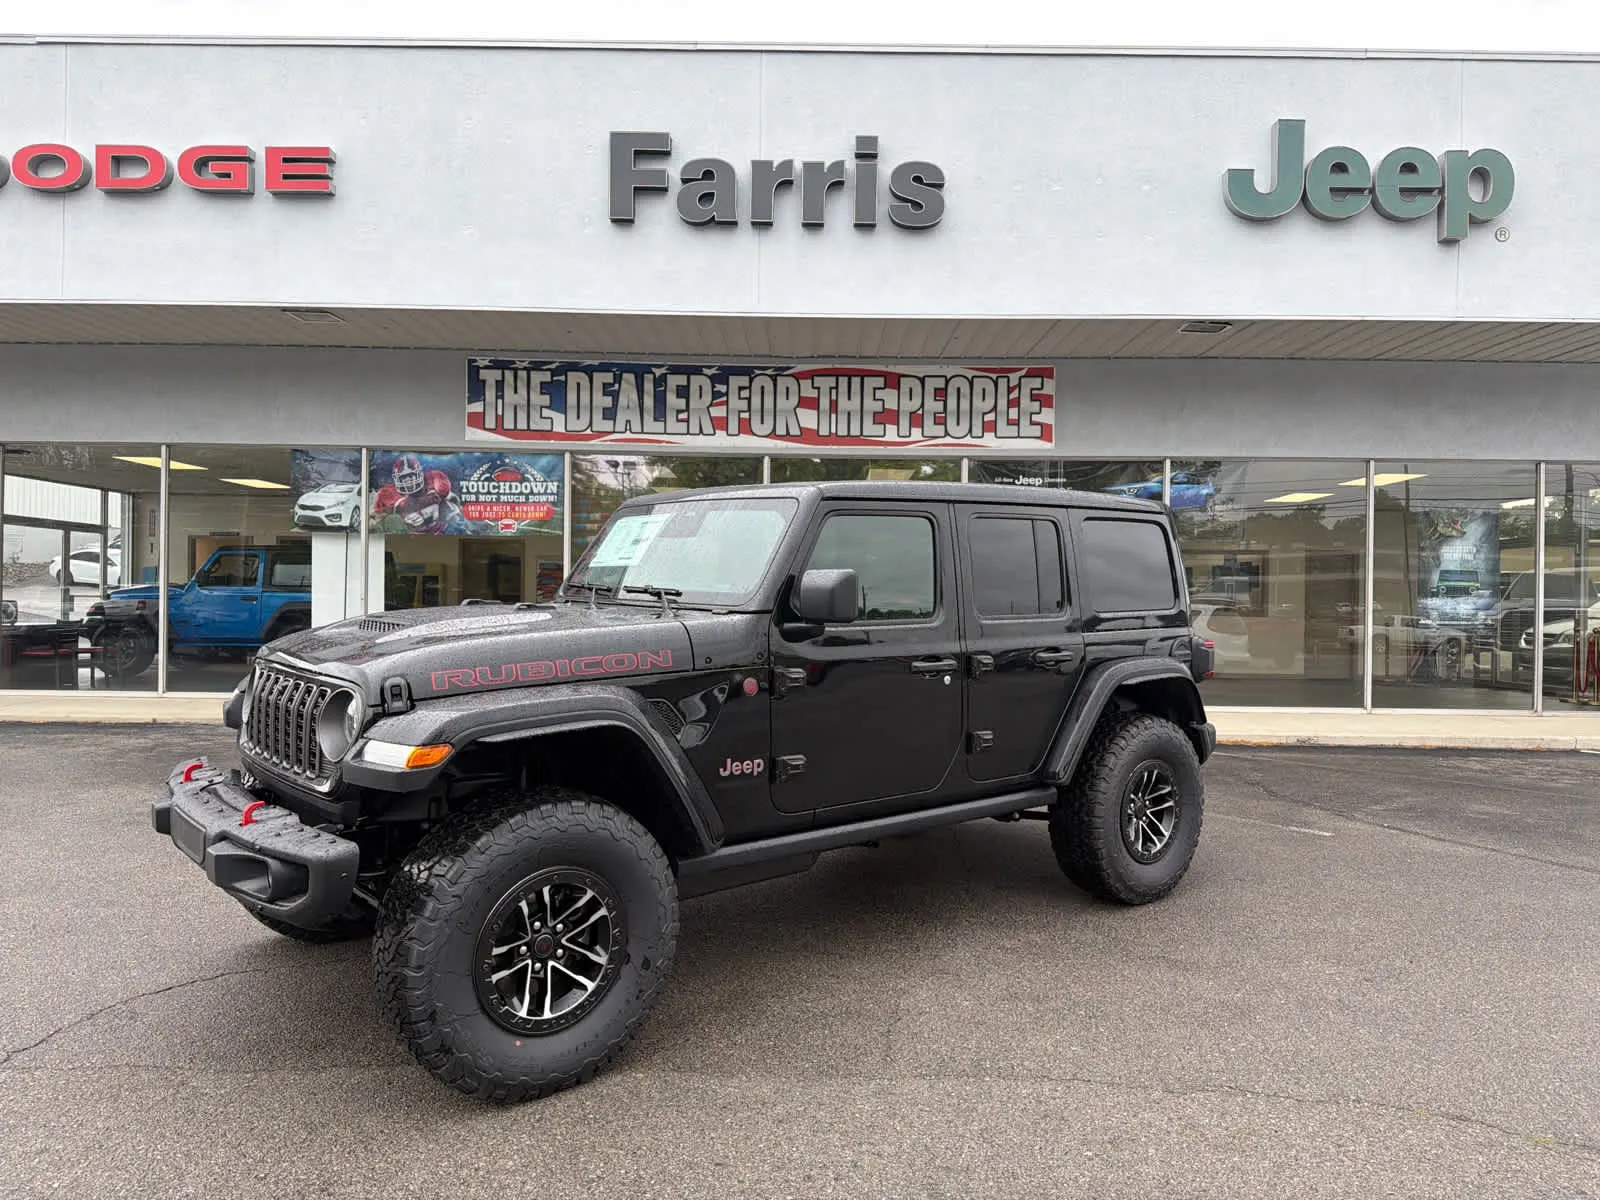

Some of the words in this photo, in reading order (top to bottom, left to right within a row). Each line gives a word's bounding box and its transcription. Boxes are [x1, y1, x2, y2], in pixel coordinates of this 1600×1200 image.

[0, 143, 337, 196] ODGE
[609, 131, 946, 230] Farris
[1223, 118, 1515, 243] Jeep
[479, 368, 553, 432] THE
[564, 371, 716, 436] DEALER
[726, 374, 802, 437] FOR
[812, 374, 887, 438] THE
[897, 375, 1045, 439] PEOPLE
[460, 481, 558, 493] TOUCHDOWN
[462, 494, 476, 502] FOR
[480, 494, 497, 502] NOT
[501, 494, 526, 502] MUCH
[529, 494, 557, 502] DOWN!
[1015, 475, 1043, 486] Jeep
[431, 649, 673, 691] RUBICON
[719, 756, 765, 777] Jeep
